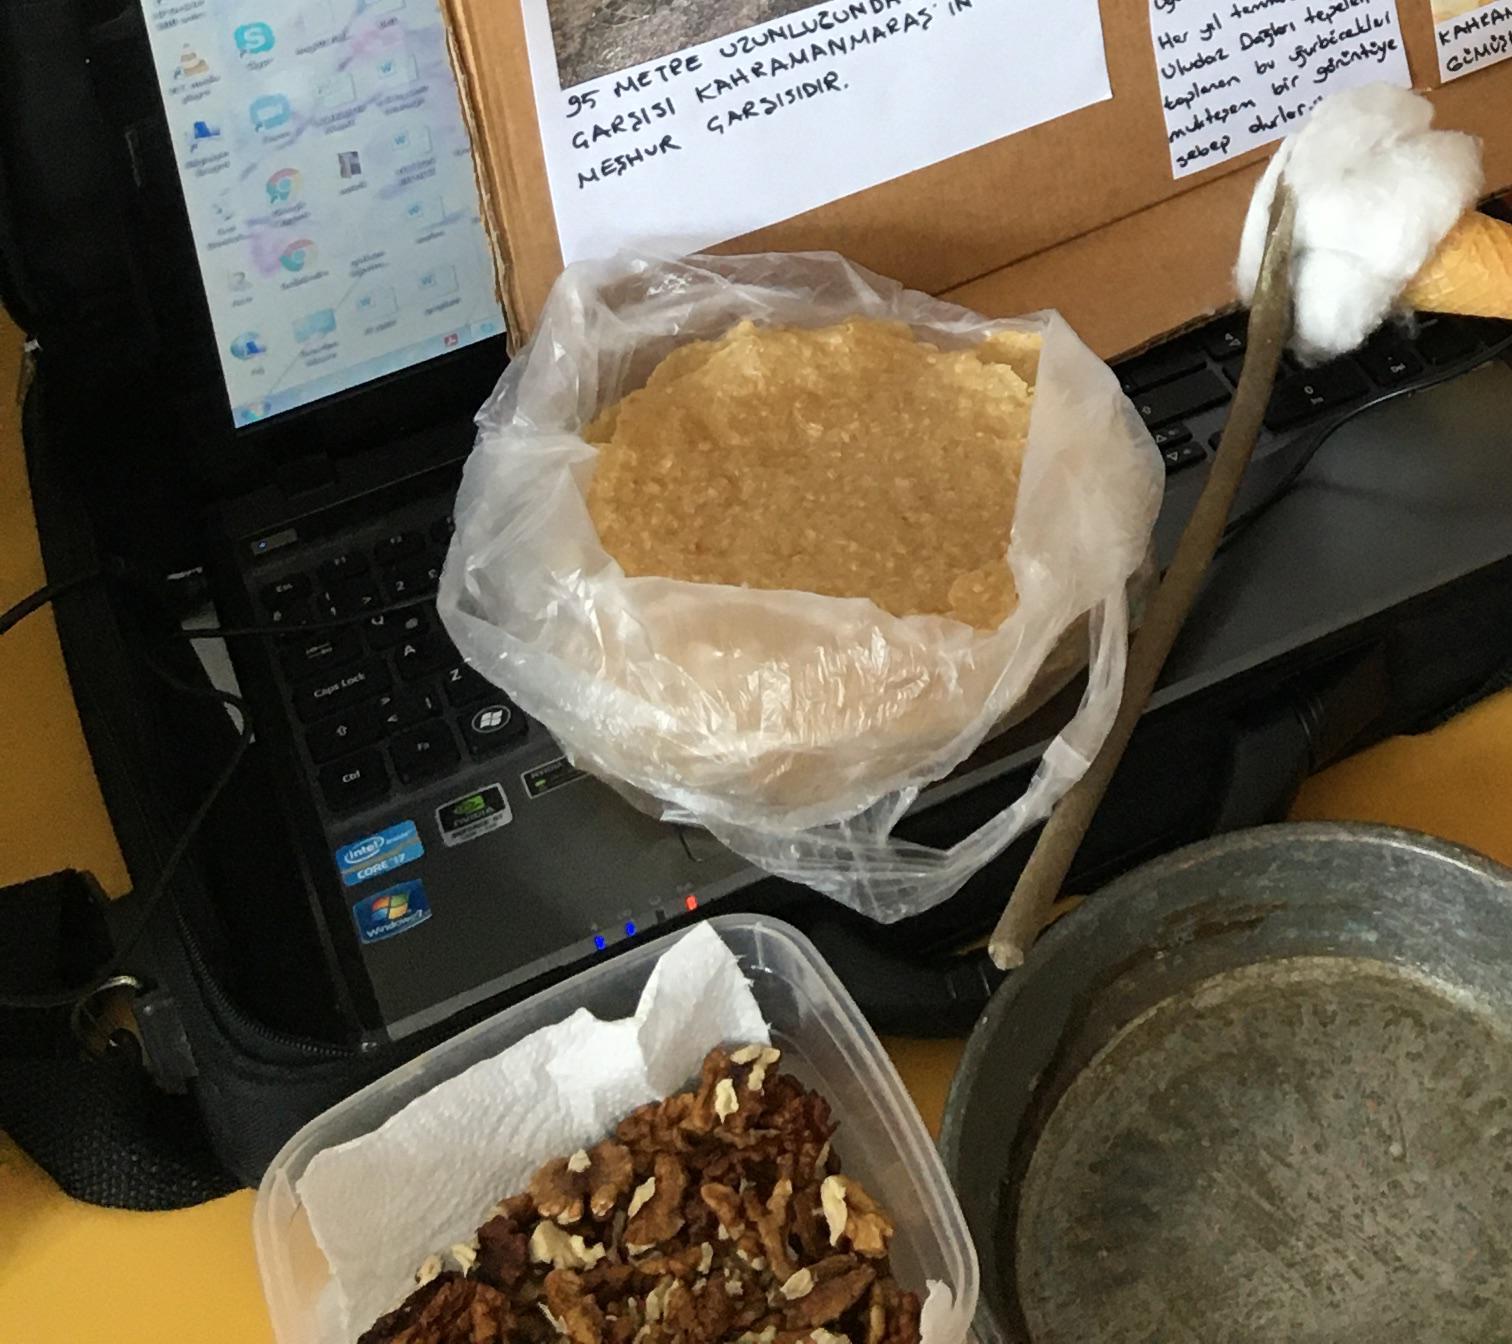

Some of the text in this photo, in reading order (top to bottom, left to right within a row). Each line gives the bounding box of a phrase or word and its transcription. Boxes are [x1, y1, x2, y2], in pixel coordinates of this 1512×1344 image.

[1157, 31, 1189, 51] Her
[1254, 59, 1276, 76] bu
[565, 89, 600, 119] 95
[613, 54, 703, 98] METRE
[1271, 74, 1300, 96] bir
[577, 135, 682, 190] MEŞHUR
[1175, 134, 1231, 169] sebep
[314, 672, 366, 698] Caps Lock
[357, 861, 388, 880] CORE
